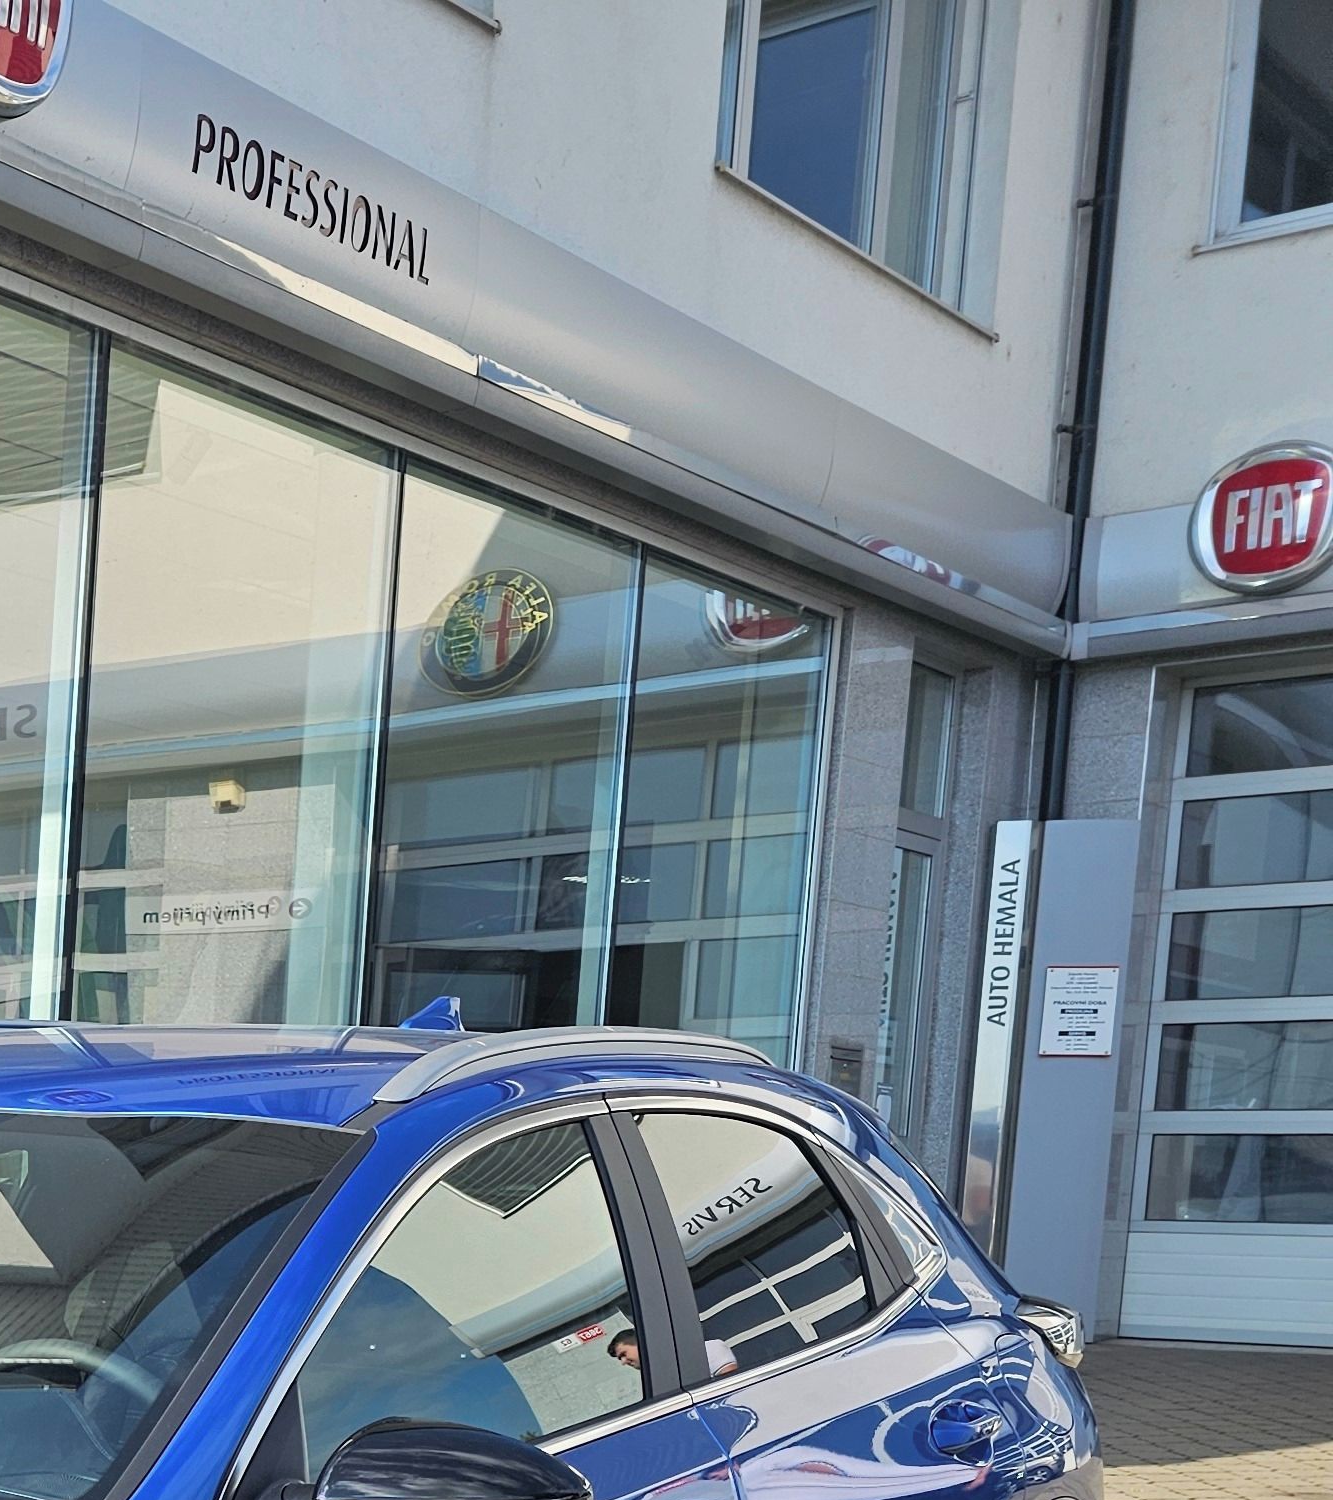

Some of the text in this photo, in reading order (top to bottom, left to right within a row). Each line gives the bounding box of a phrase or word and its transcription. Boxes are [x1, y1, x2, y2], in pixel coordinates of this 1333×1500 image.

[190, 112, 430, 286] PROFESSIONAL
[1223, 478, 1324, 554] FIAT
[986, 858, 1022, 1027] AUTO HEMALA
